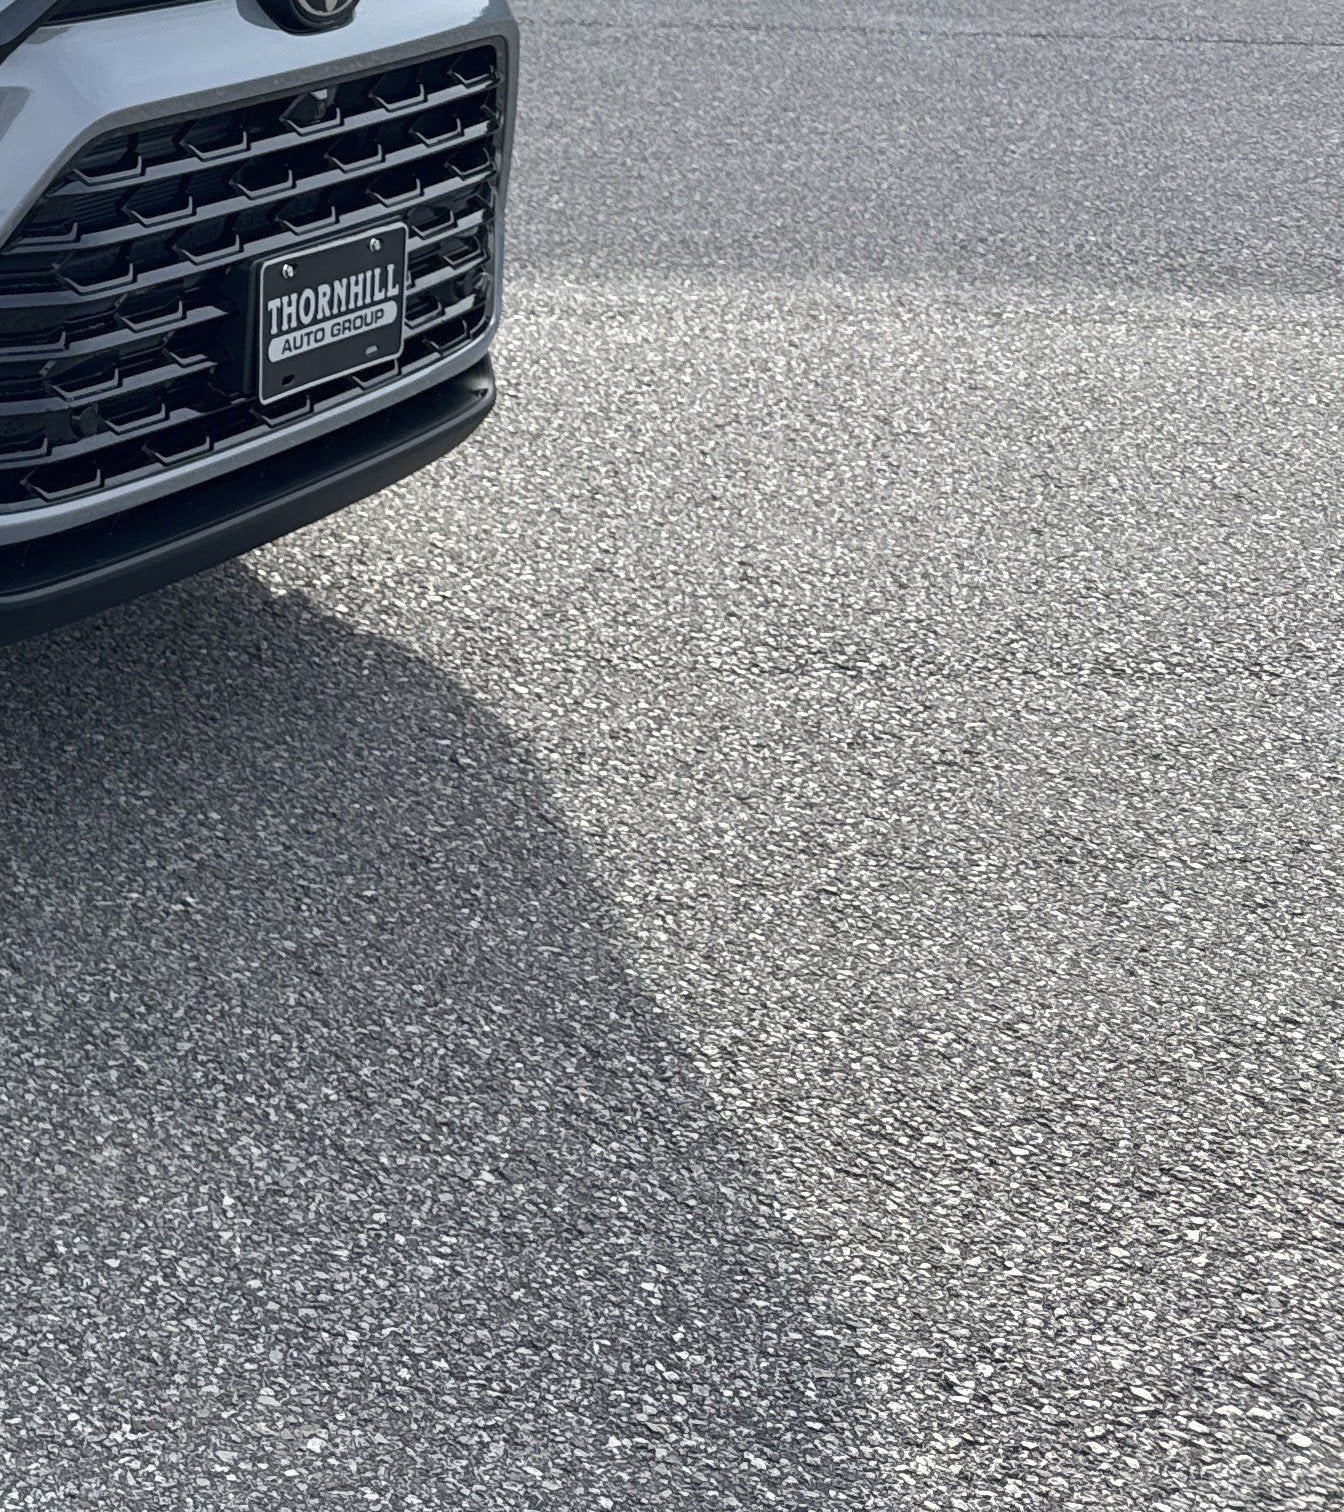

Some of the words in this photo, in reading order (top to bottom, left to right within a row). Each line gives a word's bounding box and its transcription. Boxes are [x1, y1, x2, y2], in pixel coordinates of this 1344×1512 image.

[267, 263, 400, 336] THORNHILL
[281, 327, 325, 355] AUTO
[330, 308, 384, 337] GROUP
